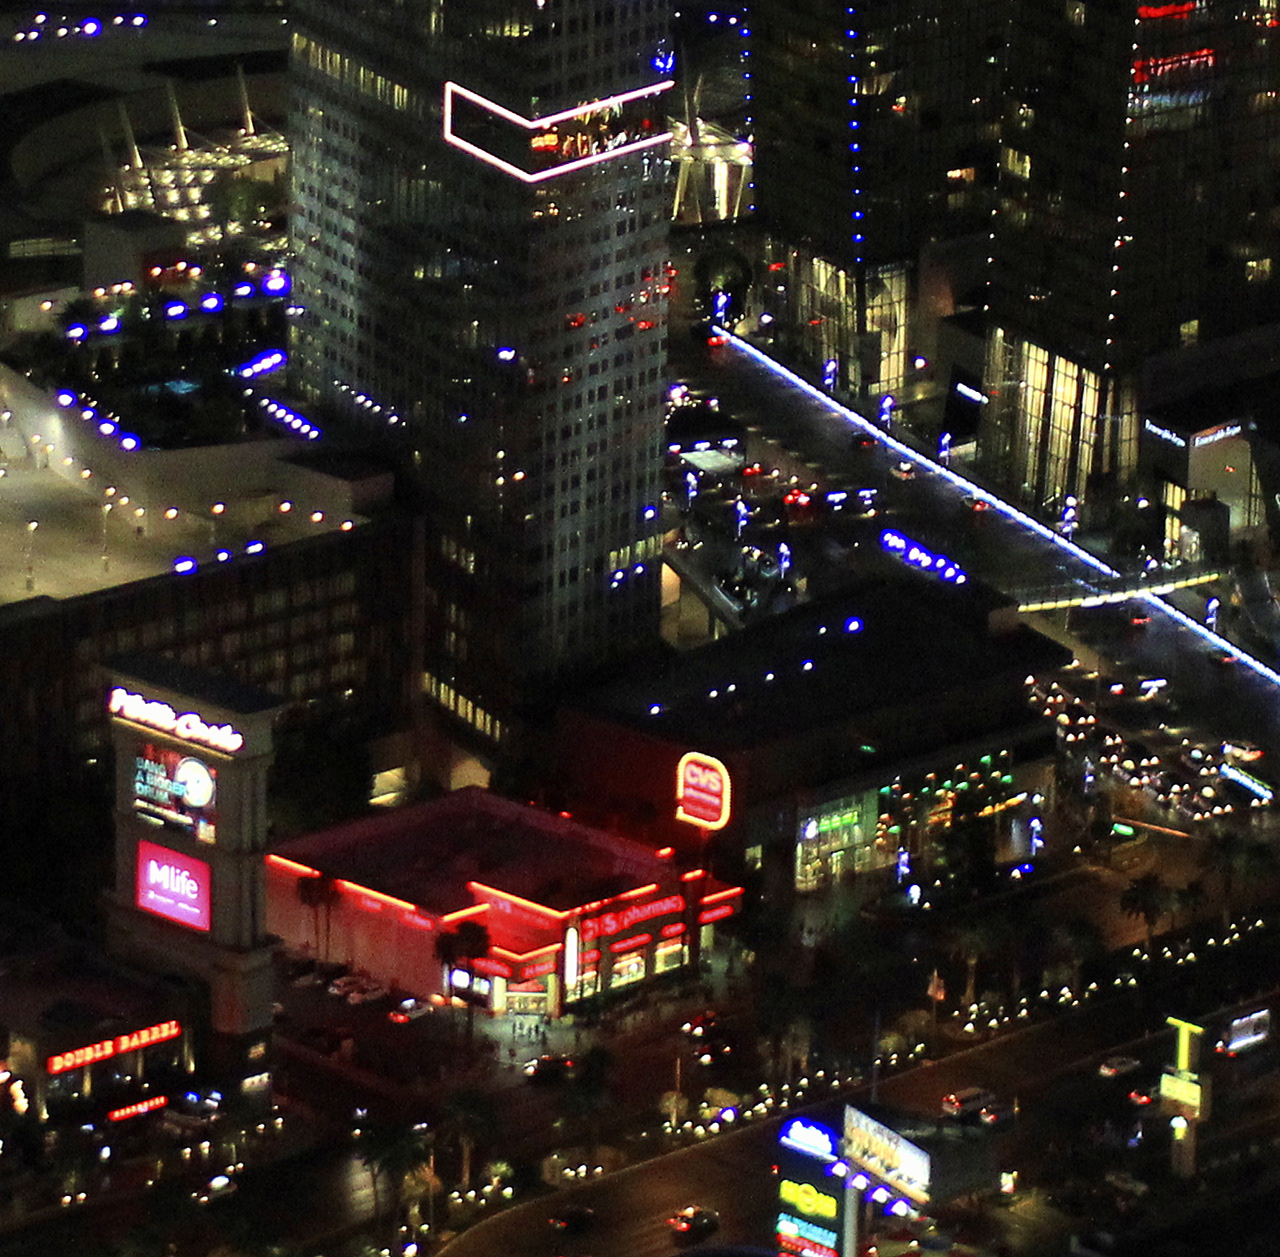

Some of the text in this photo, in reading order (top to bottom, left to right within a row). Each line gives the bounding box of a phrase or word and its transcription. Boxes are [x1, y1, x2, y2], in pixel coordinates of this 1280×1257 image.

[684, 763, 722, 793] CVS
[51, 1020, 180, 1072] DOUBLE BARREL
